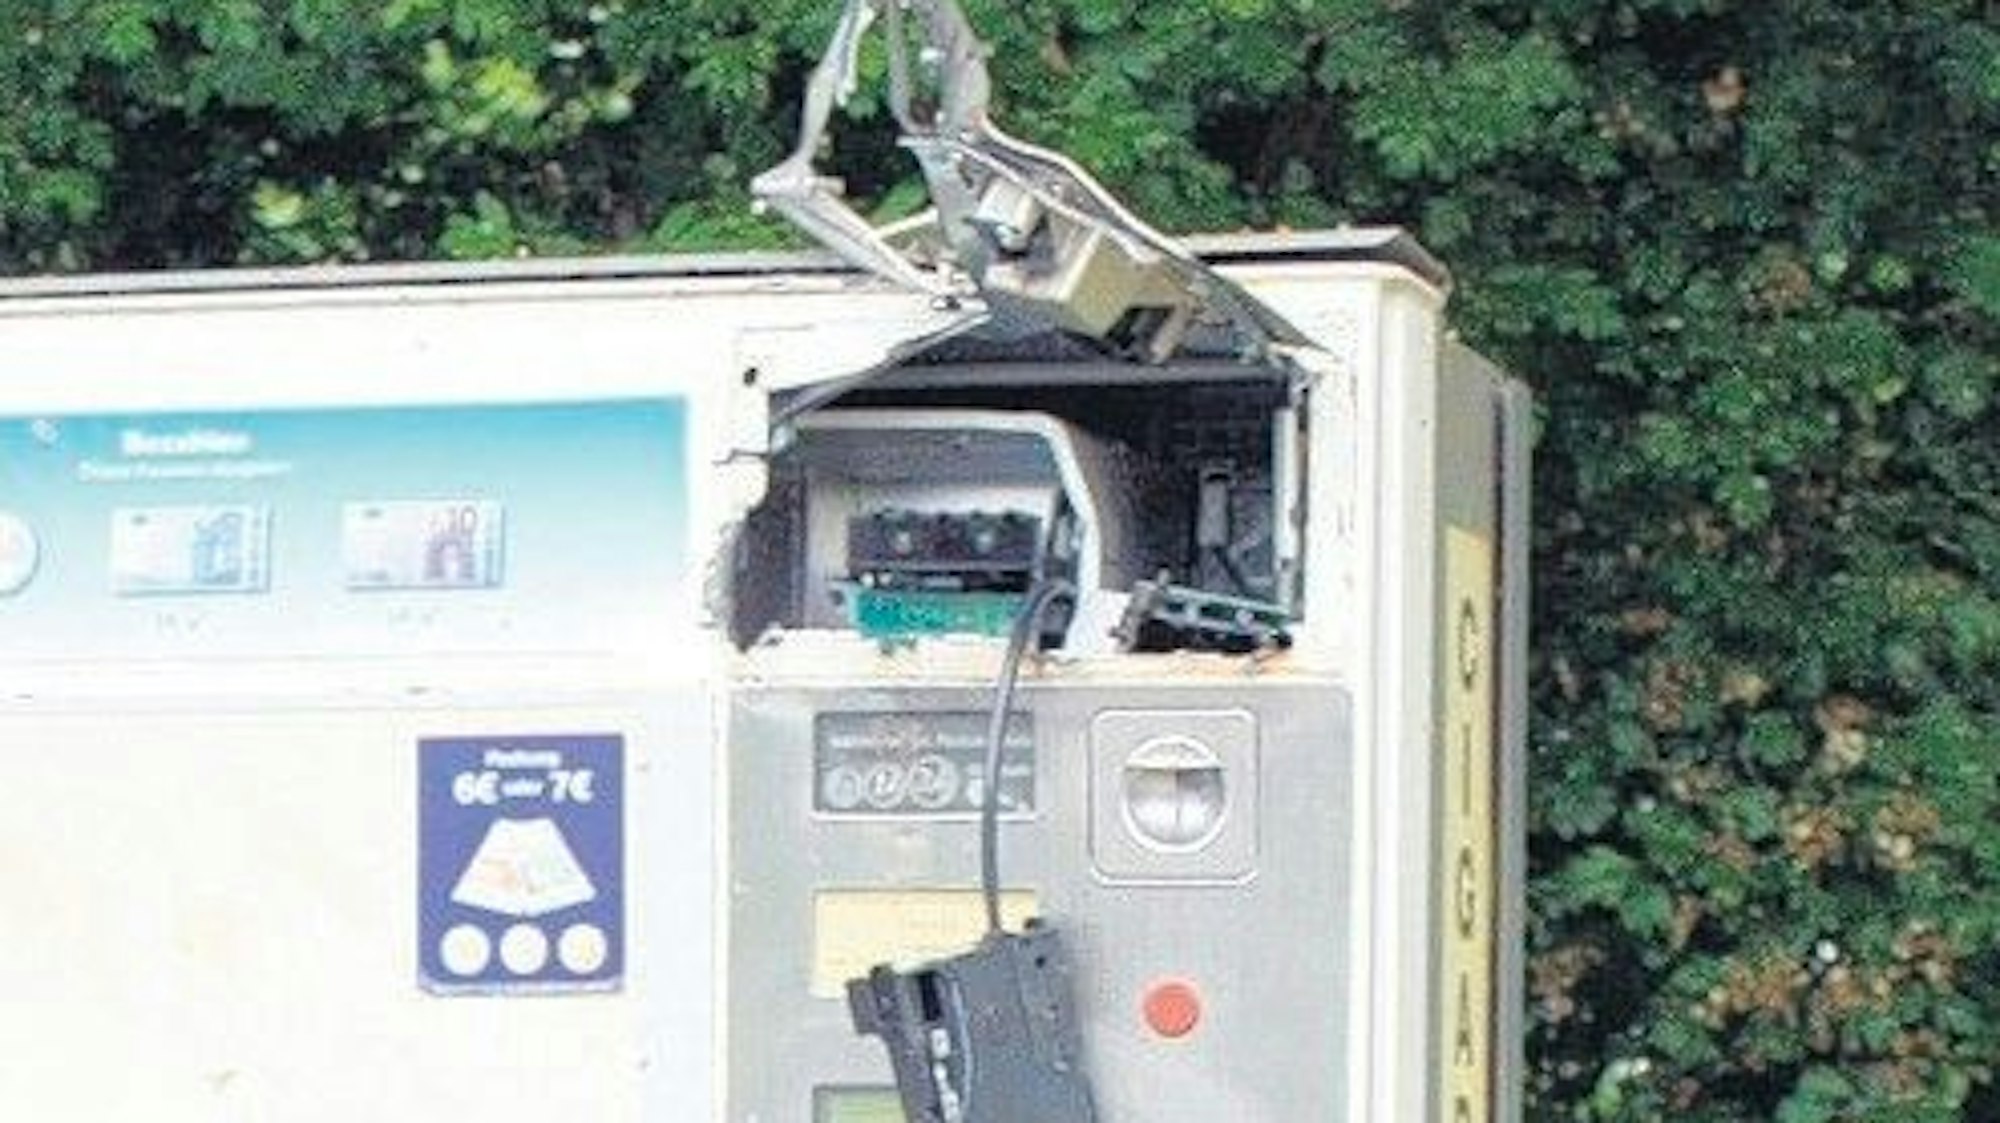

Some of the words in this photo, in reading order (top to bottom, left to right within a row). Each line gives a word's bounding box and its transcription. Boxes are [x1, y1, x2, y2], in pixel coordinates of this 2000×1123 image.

[453, 771, 499, 805] 6€
[549, 770, 595, 803] 7€
[1454, 596, 1478, 1123] CIGA
